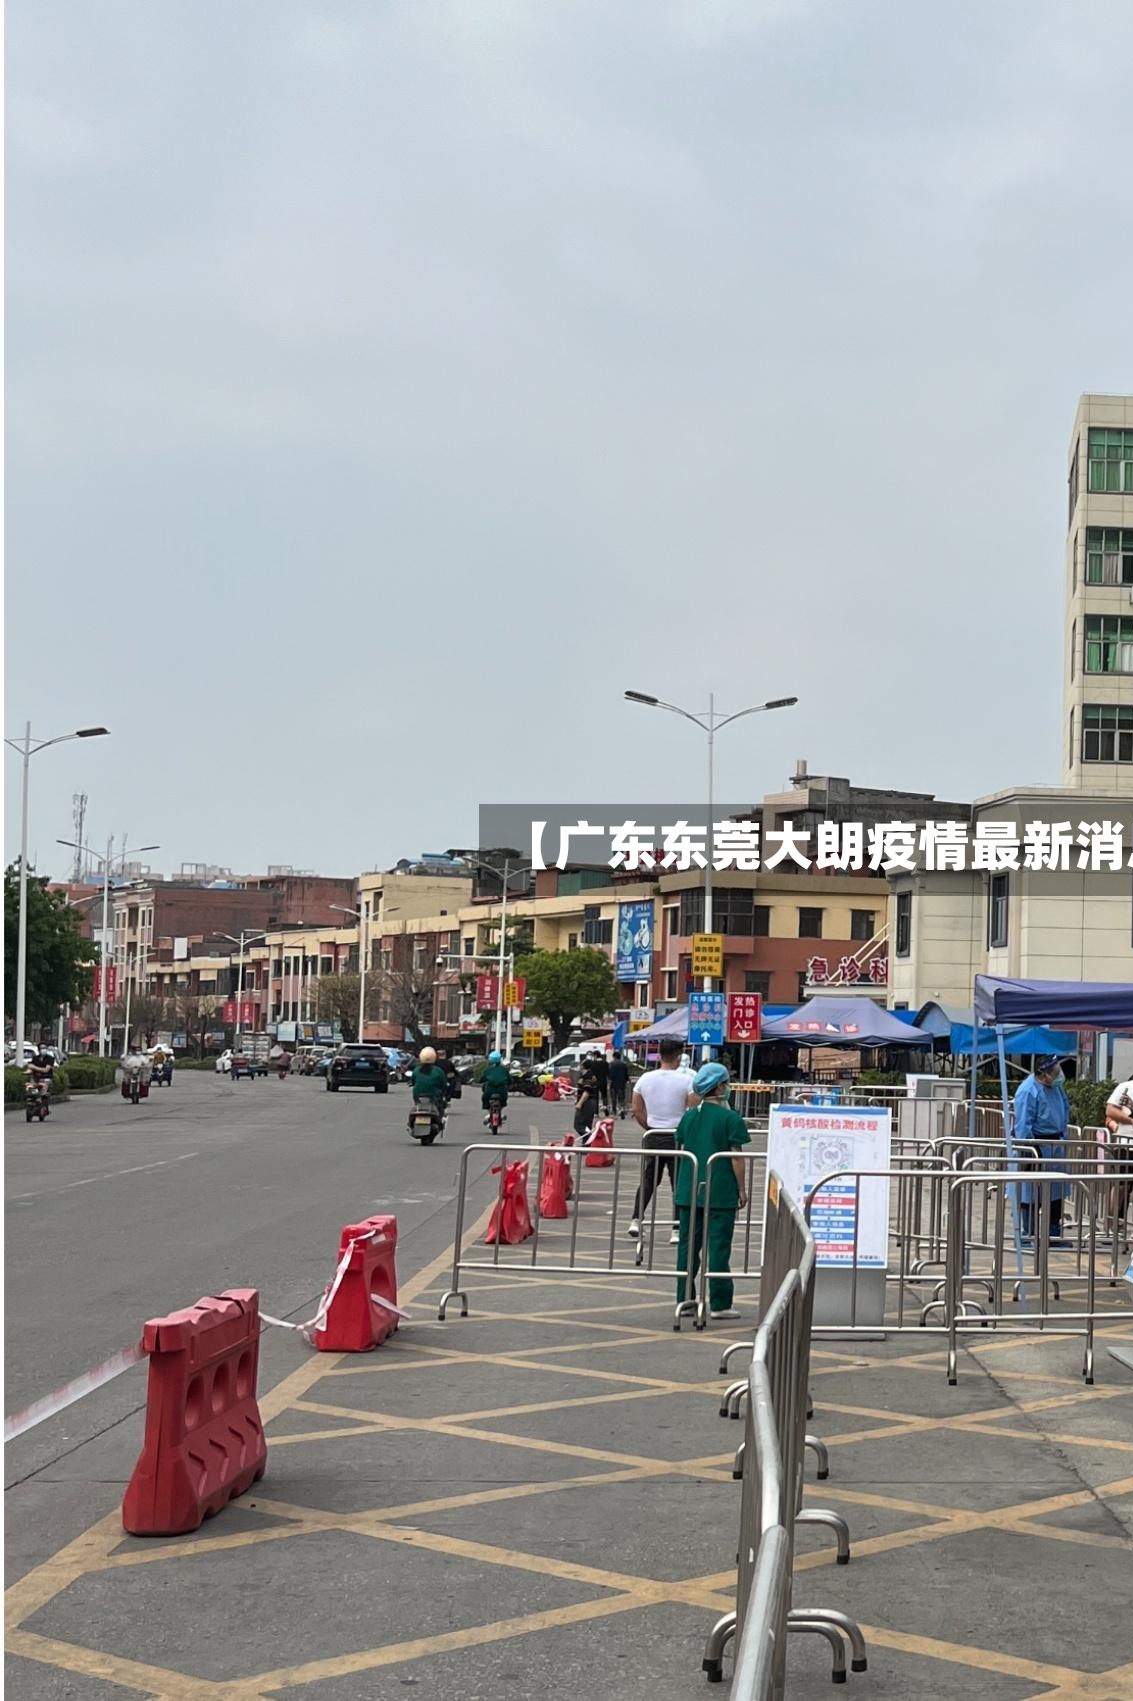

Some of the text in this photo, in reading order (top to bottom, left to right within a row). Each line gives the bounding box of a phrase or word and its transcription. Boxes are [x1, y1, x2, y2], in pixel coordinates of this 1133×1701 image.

[806, 956, 889, 987] 急诊科
[734, 996, 755, 1006] 发热
[733, 1008, 755, 1018] 门诊
[734, 1020, 753, 1029] 入口
[788, 1021, 859, 1033] 发热诊
[780, 1117, 879, 1132] 黄码核酸检测流程
